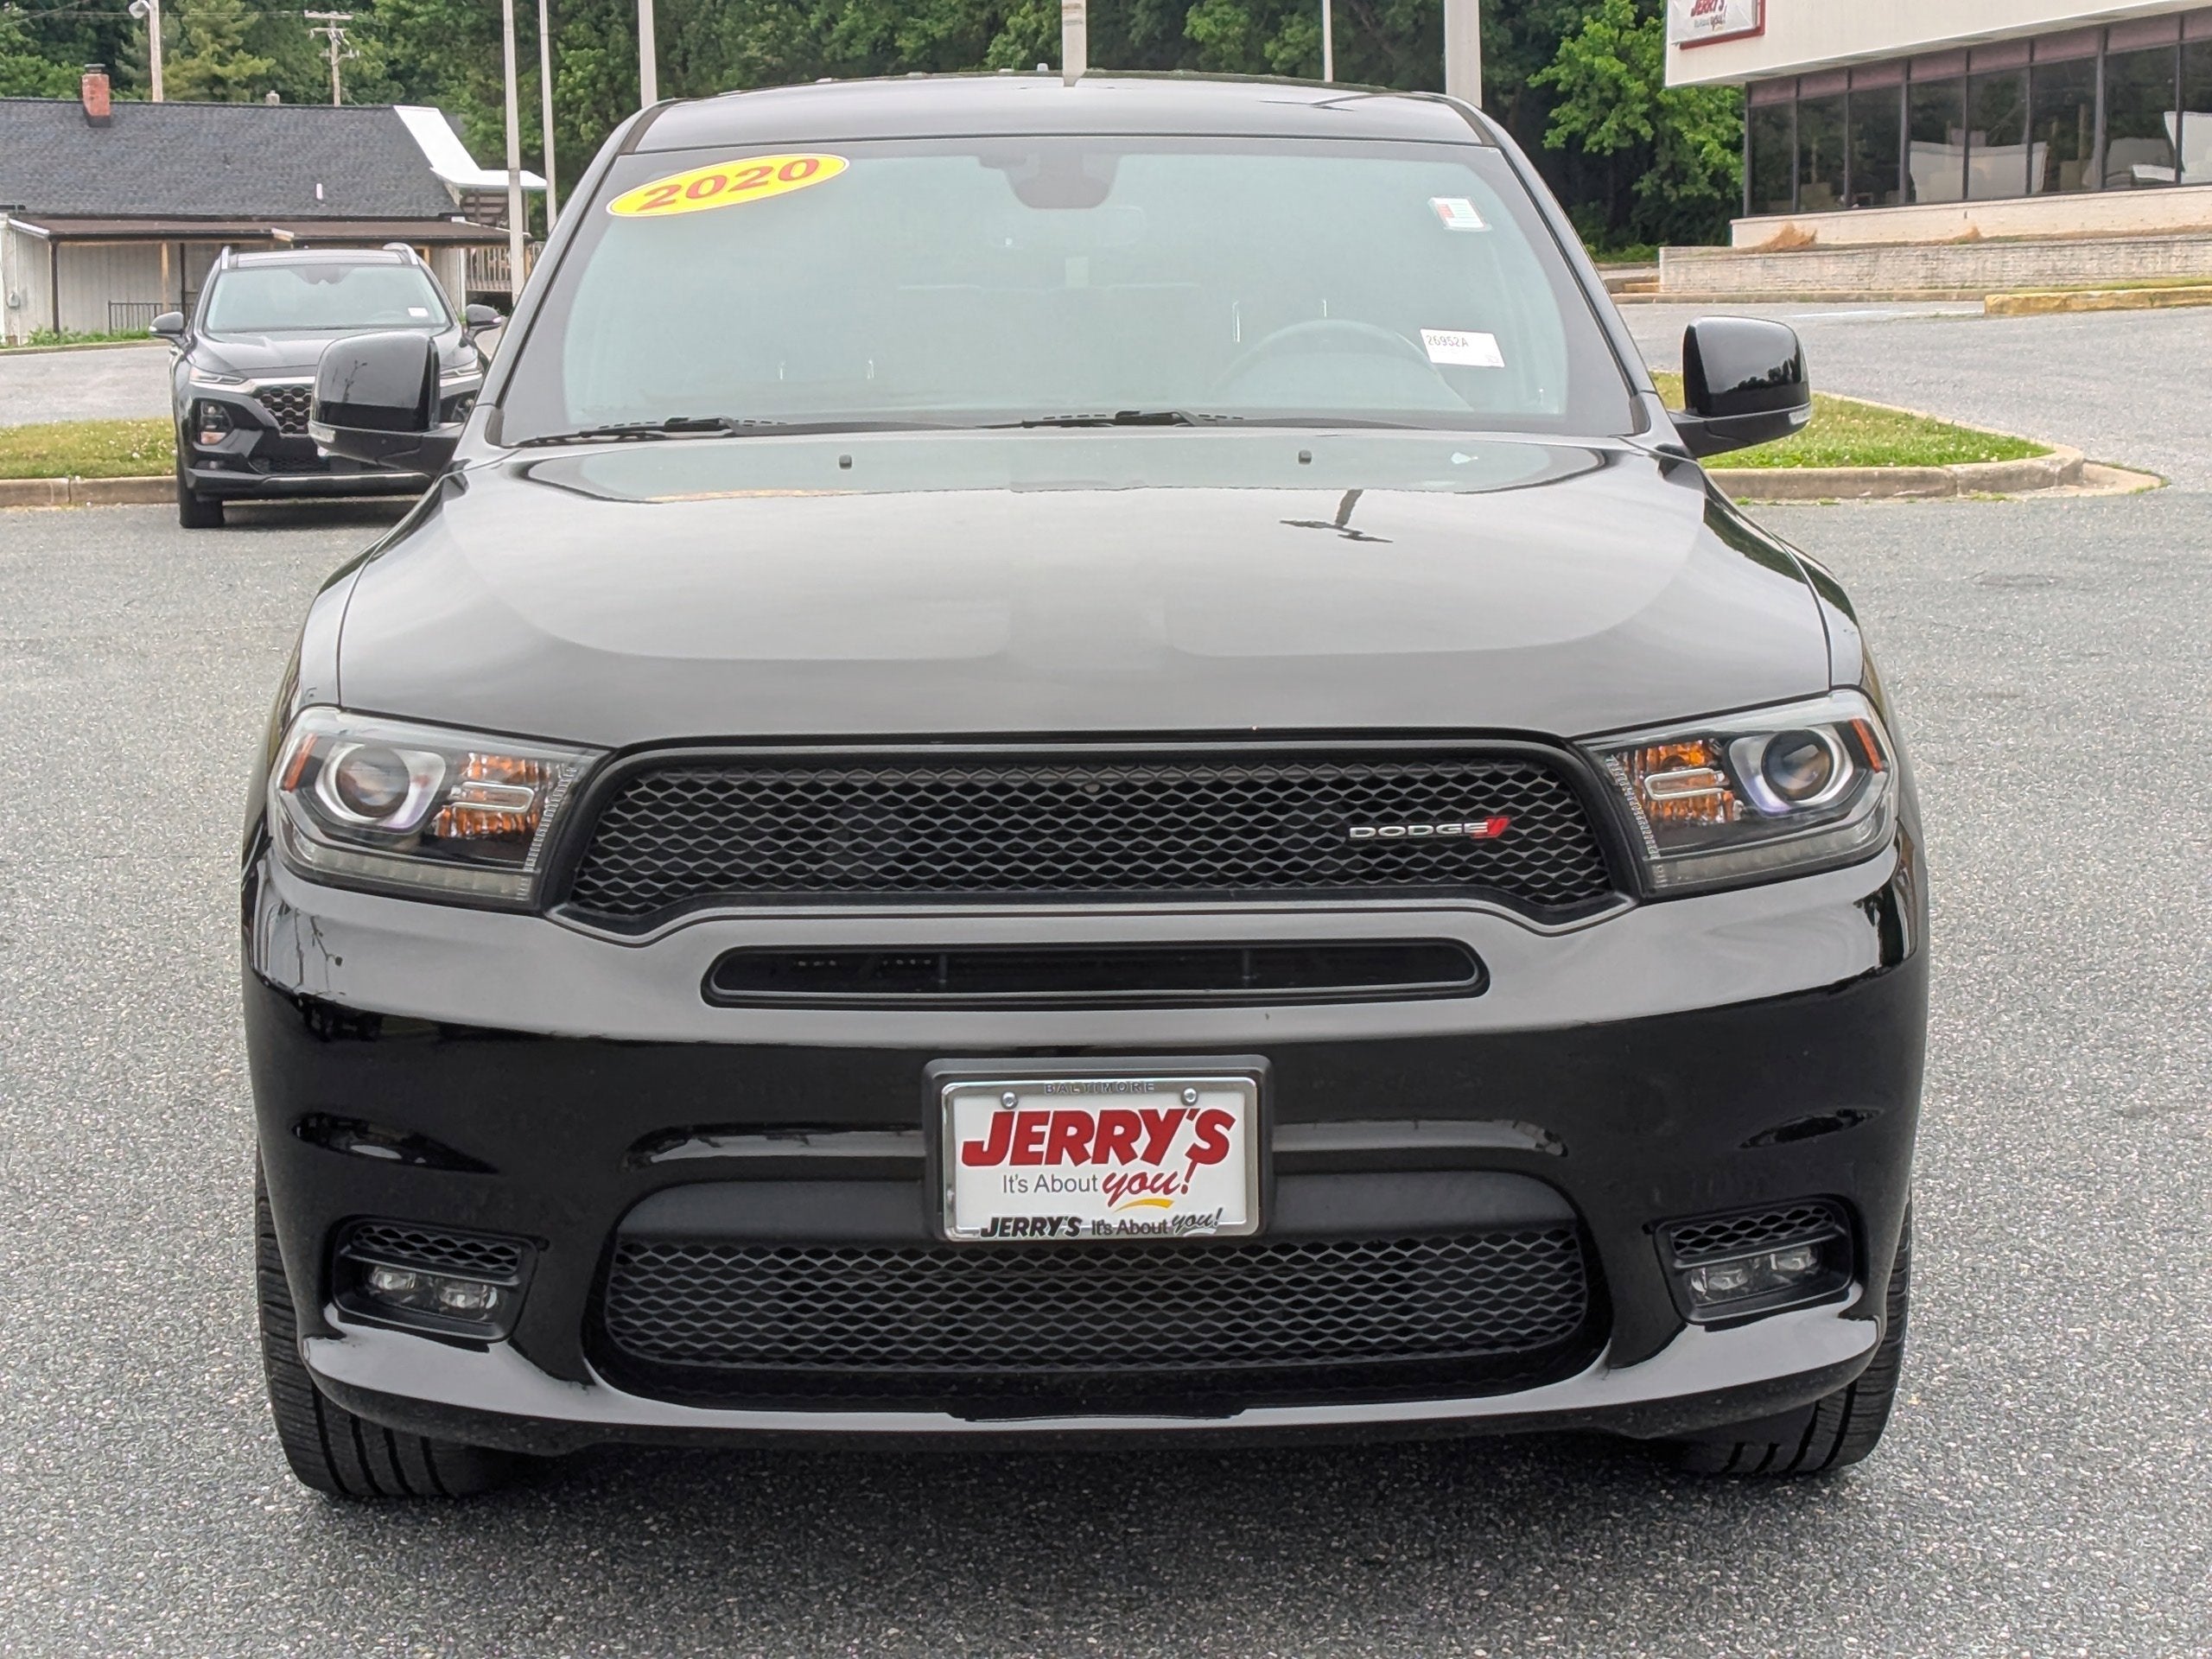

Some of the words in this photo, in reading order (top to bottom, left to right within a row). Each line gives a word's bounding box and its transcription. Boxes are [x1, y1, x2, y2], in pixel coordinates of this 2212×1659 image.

[1690, 0, 1725, 17] JERRYS
[636, 158, 819, 212] 2020
[1426, 334, 1469, 347] 26952A
[1349, 822, 1488, 838] DODGE
[1045, 1082, 1155, 1095] BALTIMORE
[962, 1108, 1236, 1166] JERRY'S
[1002, 1174, 1029, 1193] It's
[1034, 1173, 1098, 1193] About
[1103, 1159, 1198, 1208] you!
[980, 1216, 1082, 1238] JERRY'S
[1091, 1219, 1114, 1236] It's
[1119, 1218, 1168, 1236] About
[1172, 1207, 1224, 1235] you!
